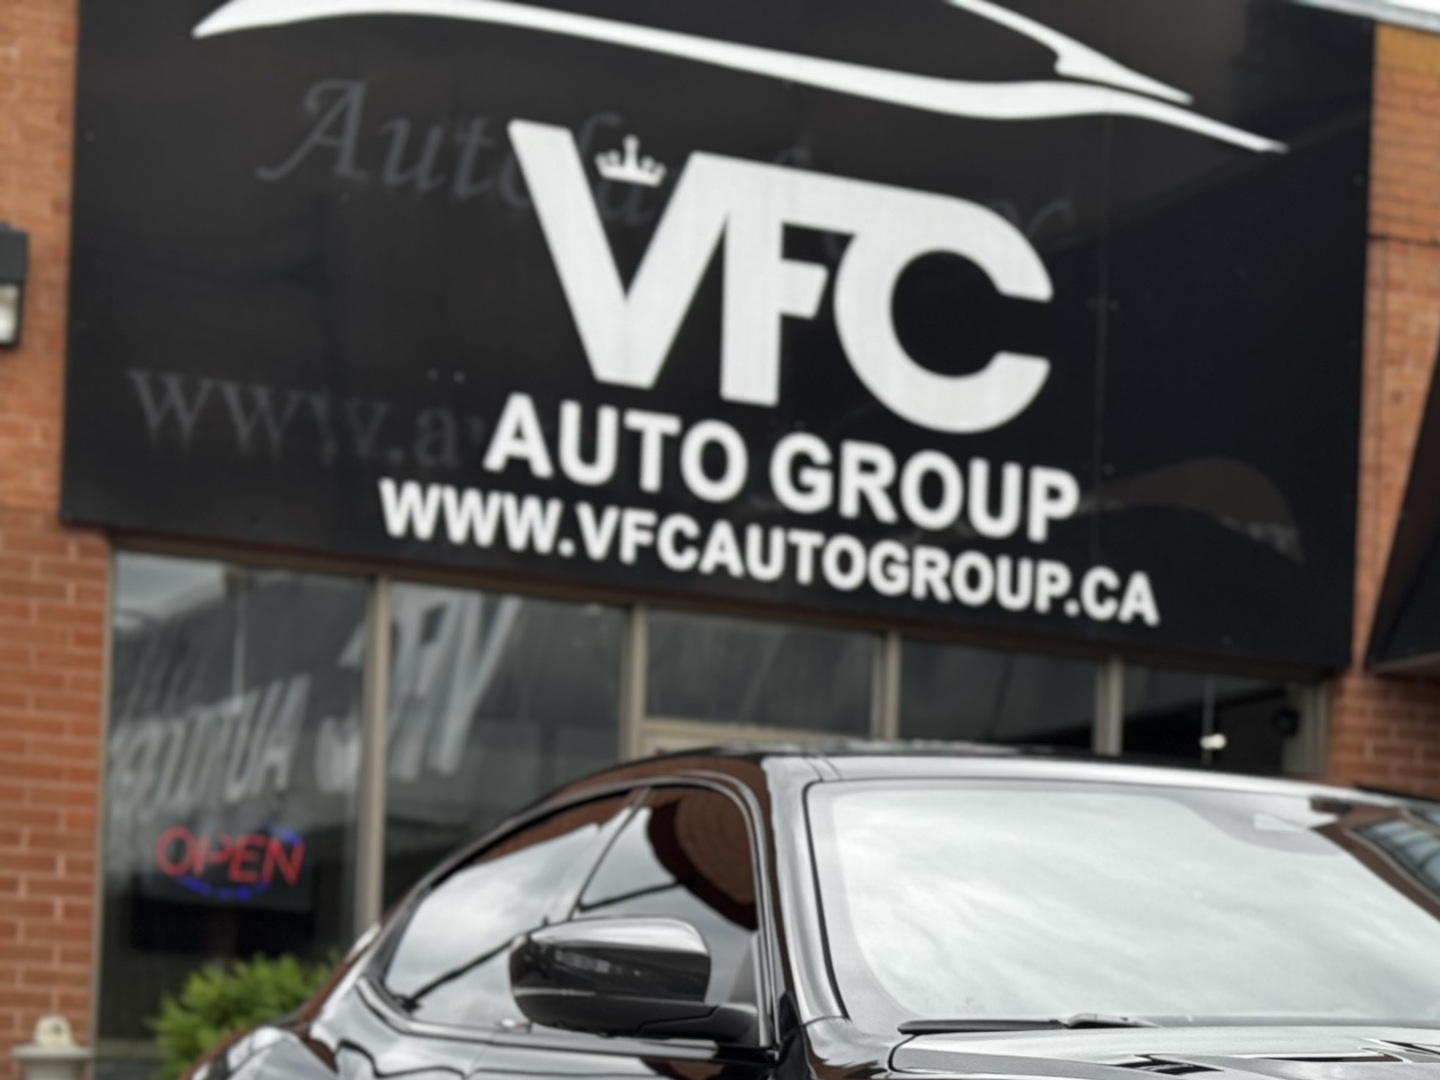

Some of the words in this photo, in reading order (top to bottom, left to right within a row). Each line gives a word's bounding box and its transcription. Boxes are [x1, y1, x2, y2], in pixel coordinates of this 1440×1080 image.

[507, 119, 1053, 434] VFC
[482, 392, 749, 502] AUTO
[769, 431, 1081, 544] GROUP
[379, 477, 1160, 627] WWW.VFCAUTOGROUP.CA
[155, 826, 305, 886] OPEN
